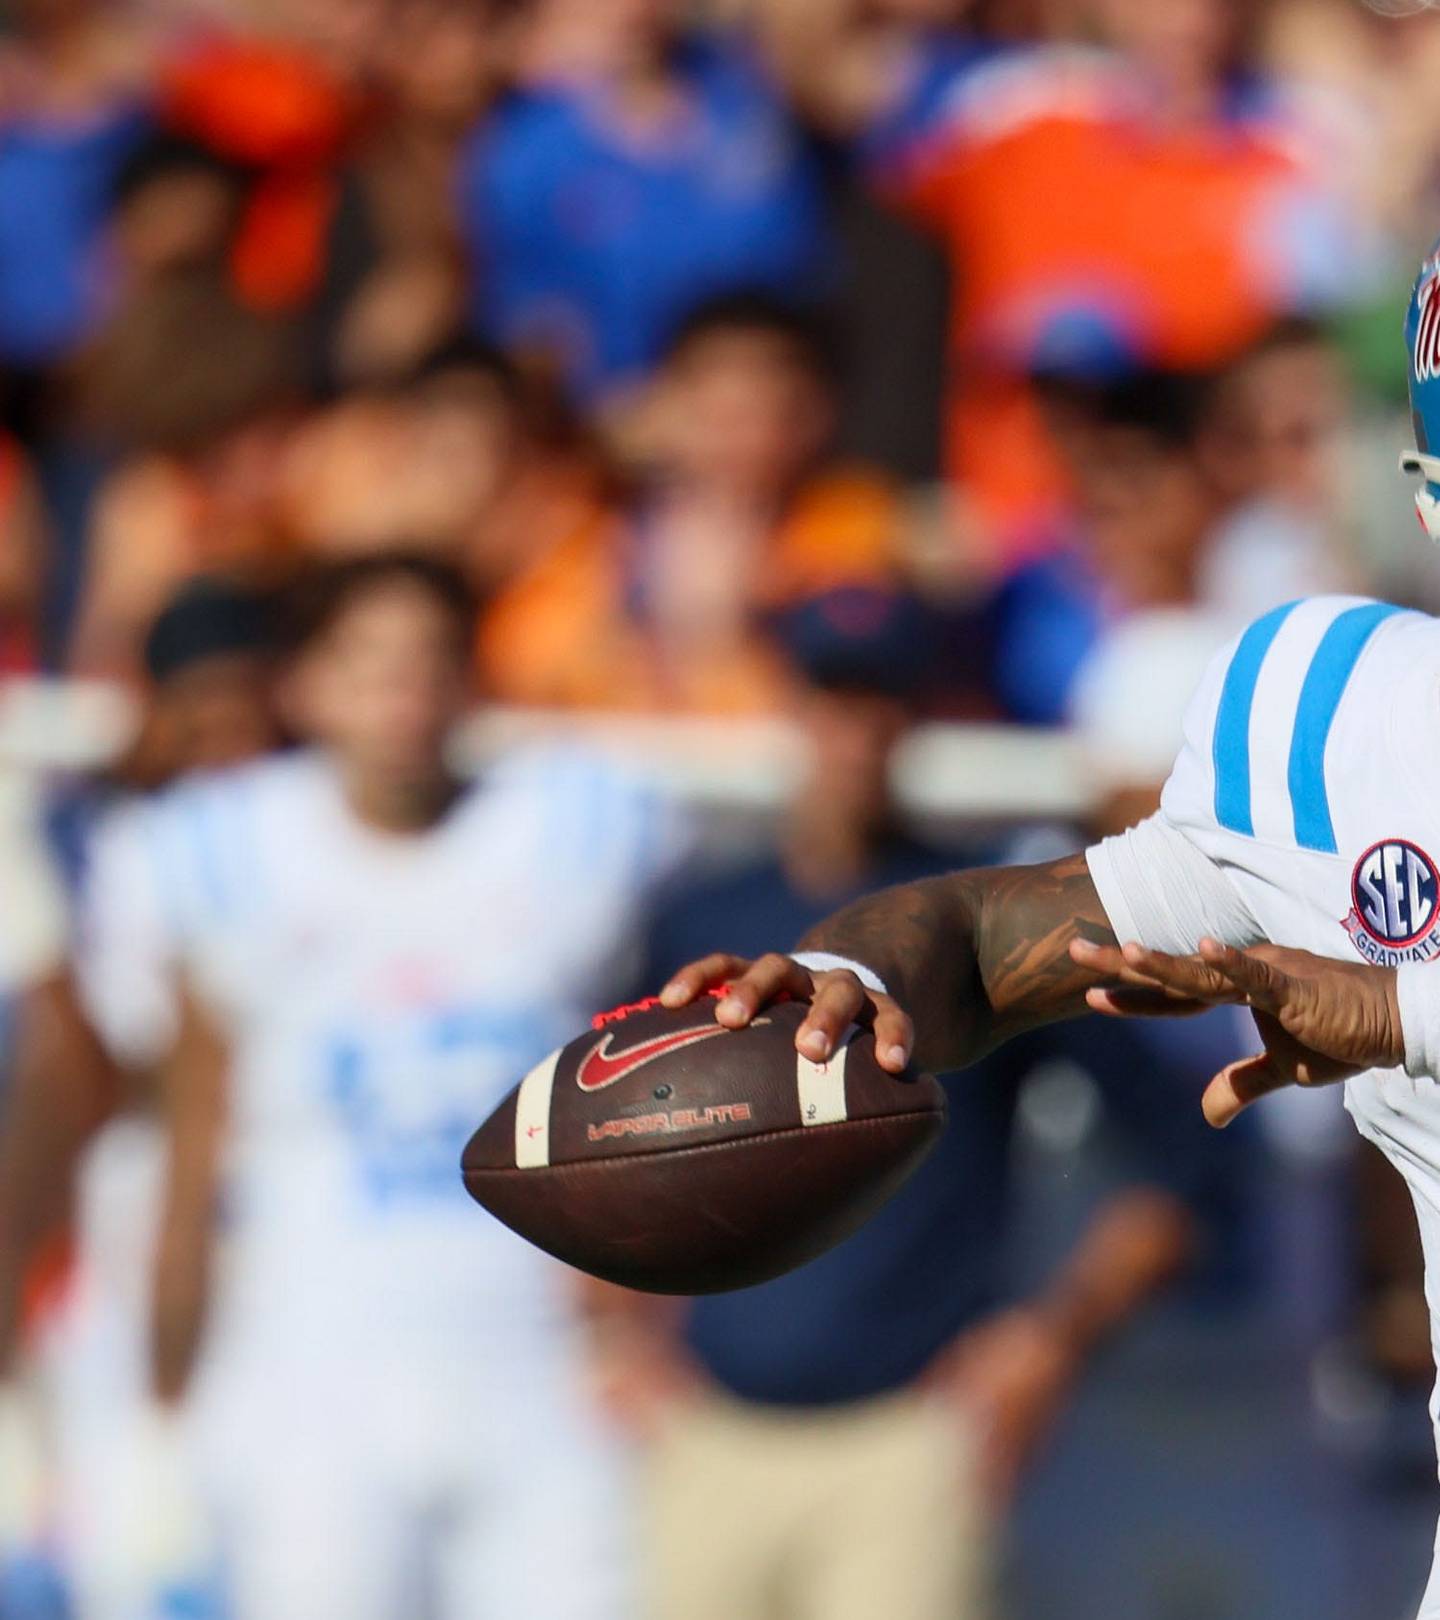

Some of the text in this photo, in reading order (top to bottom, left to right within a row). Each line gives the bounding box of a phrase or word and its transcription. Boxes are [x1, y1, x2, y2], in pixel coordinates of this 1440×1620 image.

[1358, 844, 1432, 938] SEC
[587, 1103, 751, 1142] VAPOR ELITE
